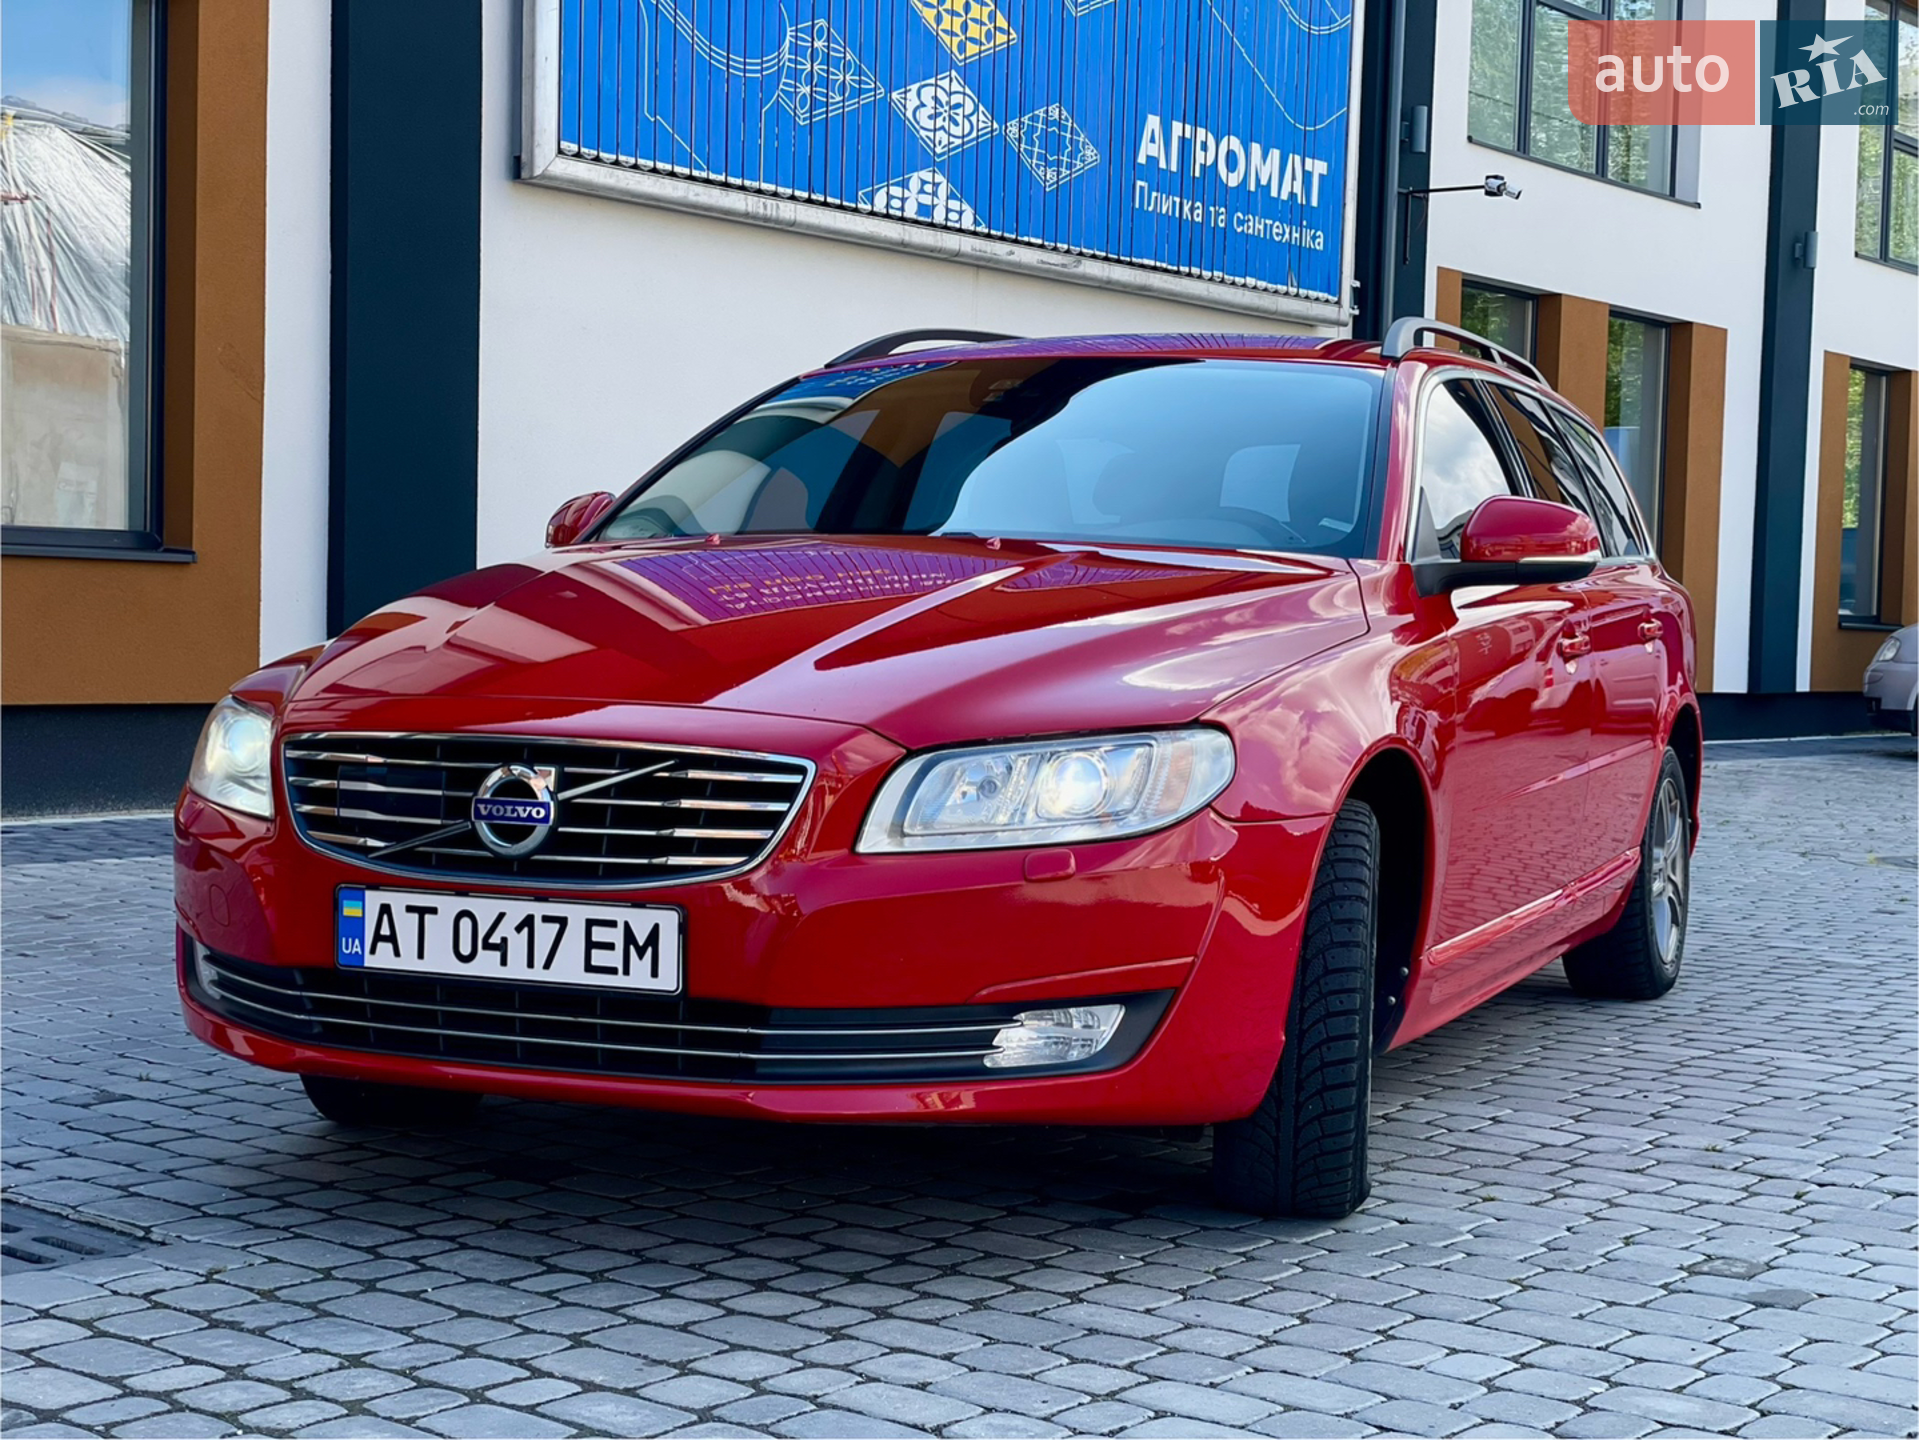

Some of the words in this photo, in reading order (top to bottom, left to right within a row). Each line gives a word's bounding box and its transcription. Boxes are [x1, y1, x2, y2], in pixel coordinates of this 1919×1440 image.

[1136, 113, 1329, 208] АГРОМАТ
[1135, 179, 1203, 224] Плитка
[1209, 205, 1227, 228] та
[1233, 211, 1325, 251] сантехніка
[476, 803, 546, 819] VOLVO
[341, 936, 362, 955] UA
[369, 902, 439, 960] AT
[452, 909, 569, 971] 0417
[583, 917, 660, 979] EM
